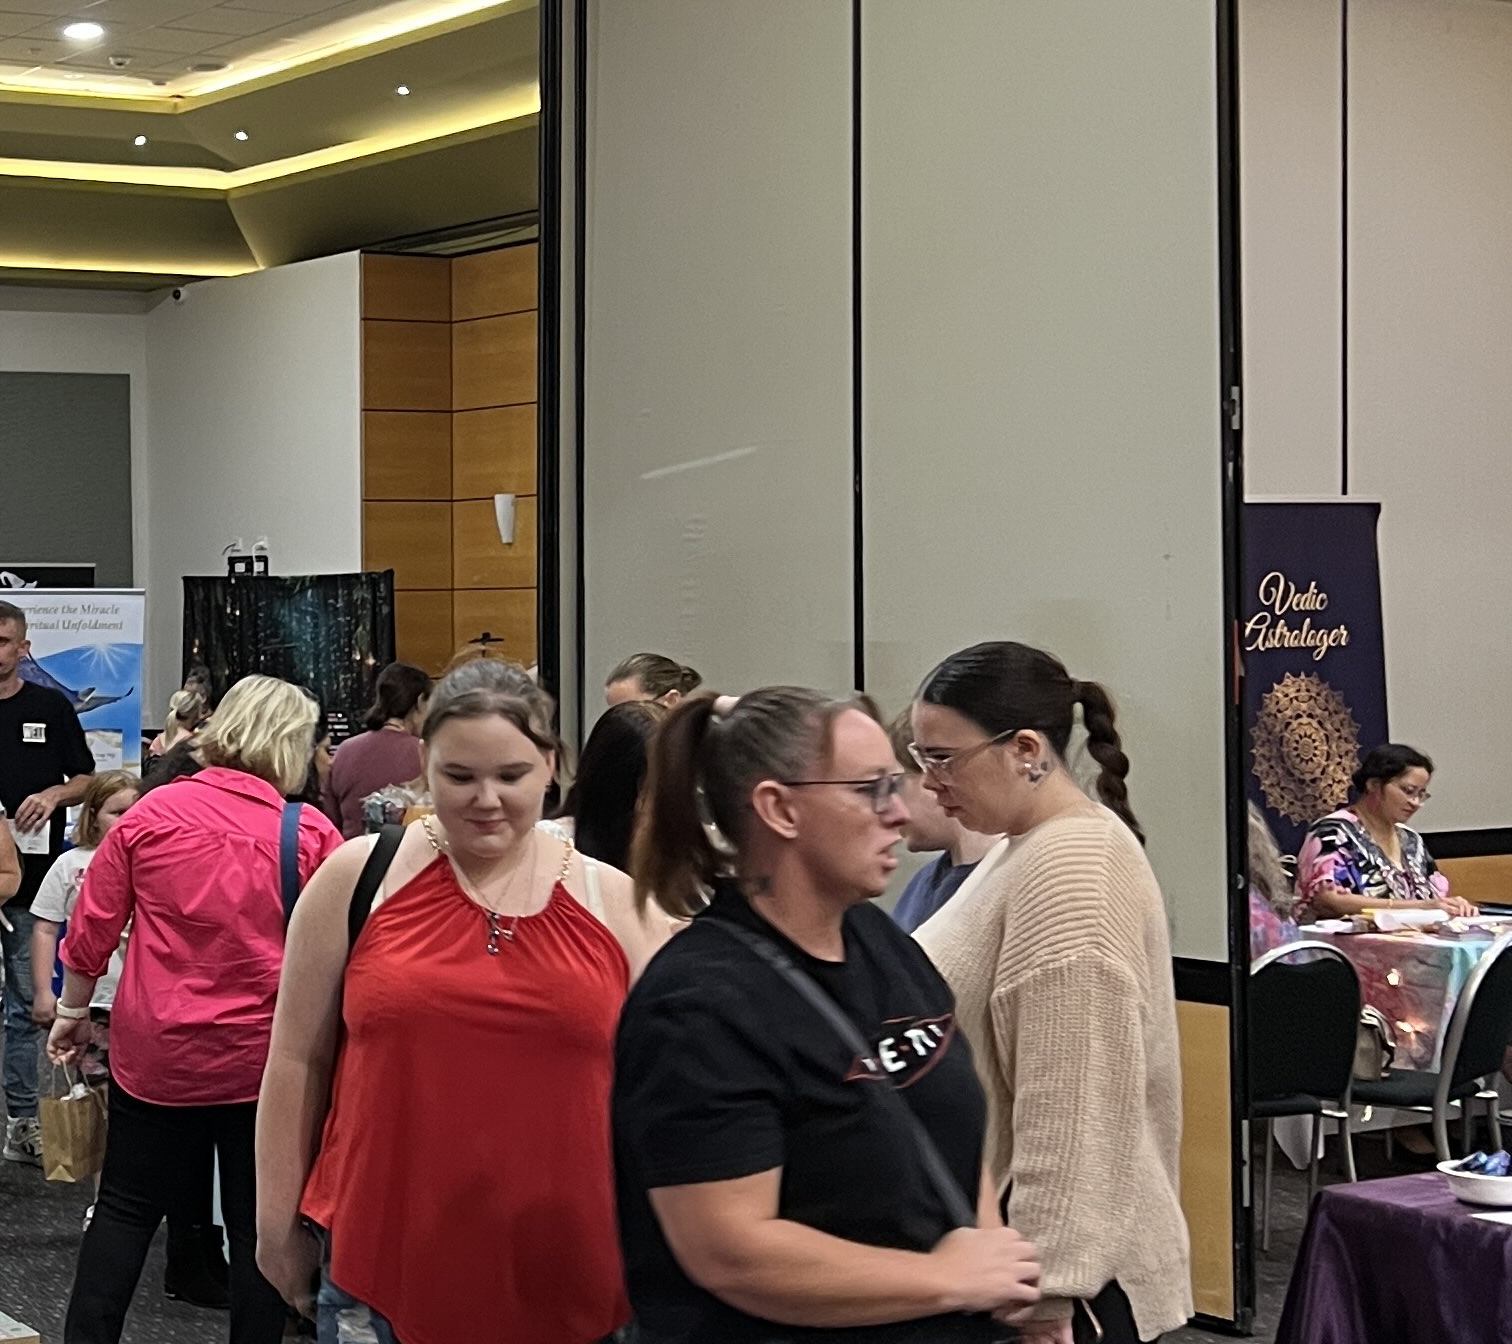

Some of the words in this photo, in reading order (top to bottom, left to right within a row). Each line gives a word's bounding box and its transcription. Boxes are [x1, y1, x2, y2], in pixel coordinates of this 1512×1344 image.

[1259, 571, 1328, 615] Vedic
[61, 604, 78, 615] the
[79, 604, 120, 615] Miracle
[62, 619, 123, 633] Unfoldment
[1245, 612, 1349, 661] Astrologer
